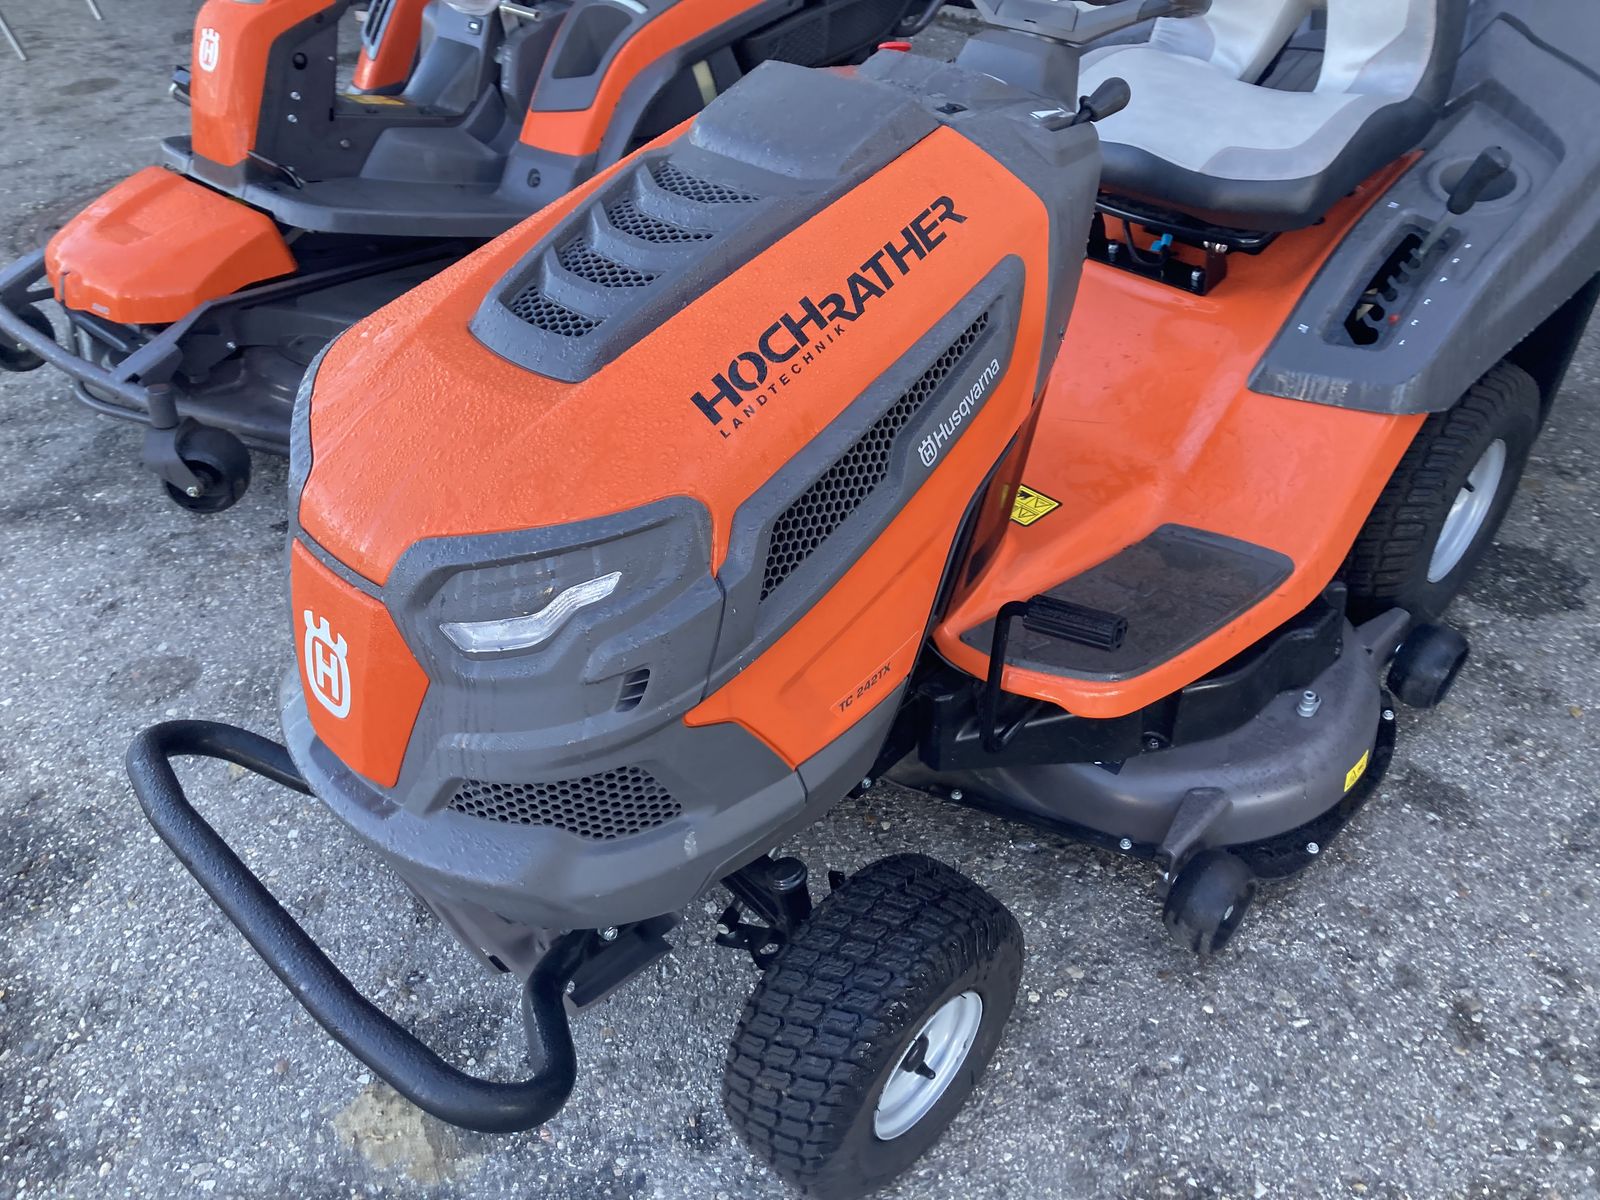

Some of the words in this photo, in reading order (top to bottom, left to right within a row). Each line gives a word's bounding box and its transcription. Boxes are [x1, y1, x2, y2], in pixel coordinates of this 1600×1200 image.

[690, 195, 968, 426] HOCHRATHER
[719, 324, 846, 439] LANDTECHNIK
[933, 358, 1000, 448] Husqvarna
[839, 695, 853, 712] TC
[857, 661, 891, 699] 242TX
